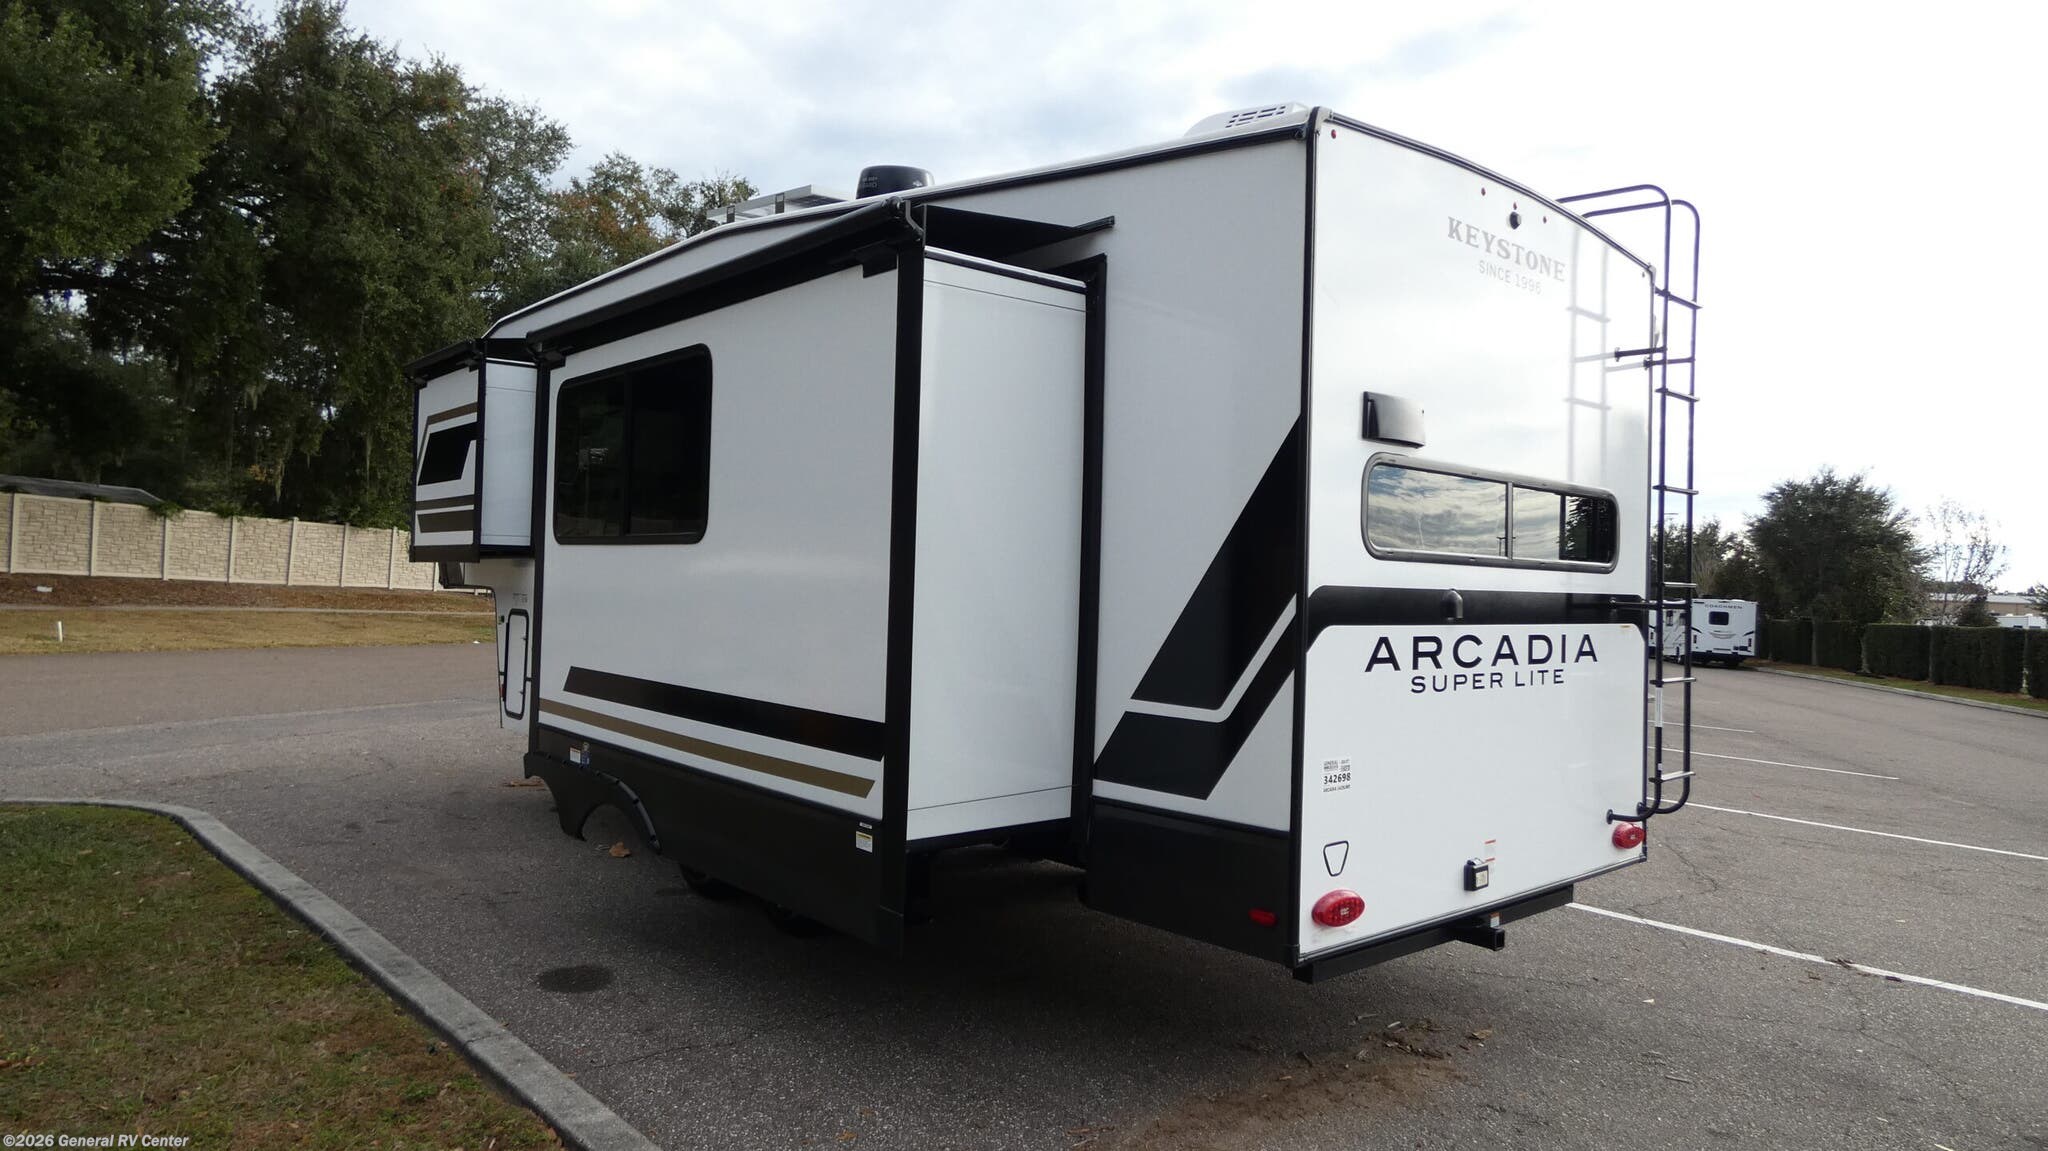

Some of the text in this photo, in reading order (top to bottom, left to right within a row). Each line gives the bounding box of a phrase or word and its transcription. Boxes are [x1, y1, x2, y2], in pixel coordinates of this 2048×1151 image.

[1447, 215, 1566, 282] KEYSTONE
[1479, 259, 1542, 295] SINCE 1996
[1364, 633, 1598, 673] ARCADIA
[1410, 668, 1565, 694] SUPER LITE
[1323, 772, 1351, 785] 342698
